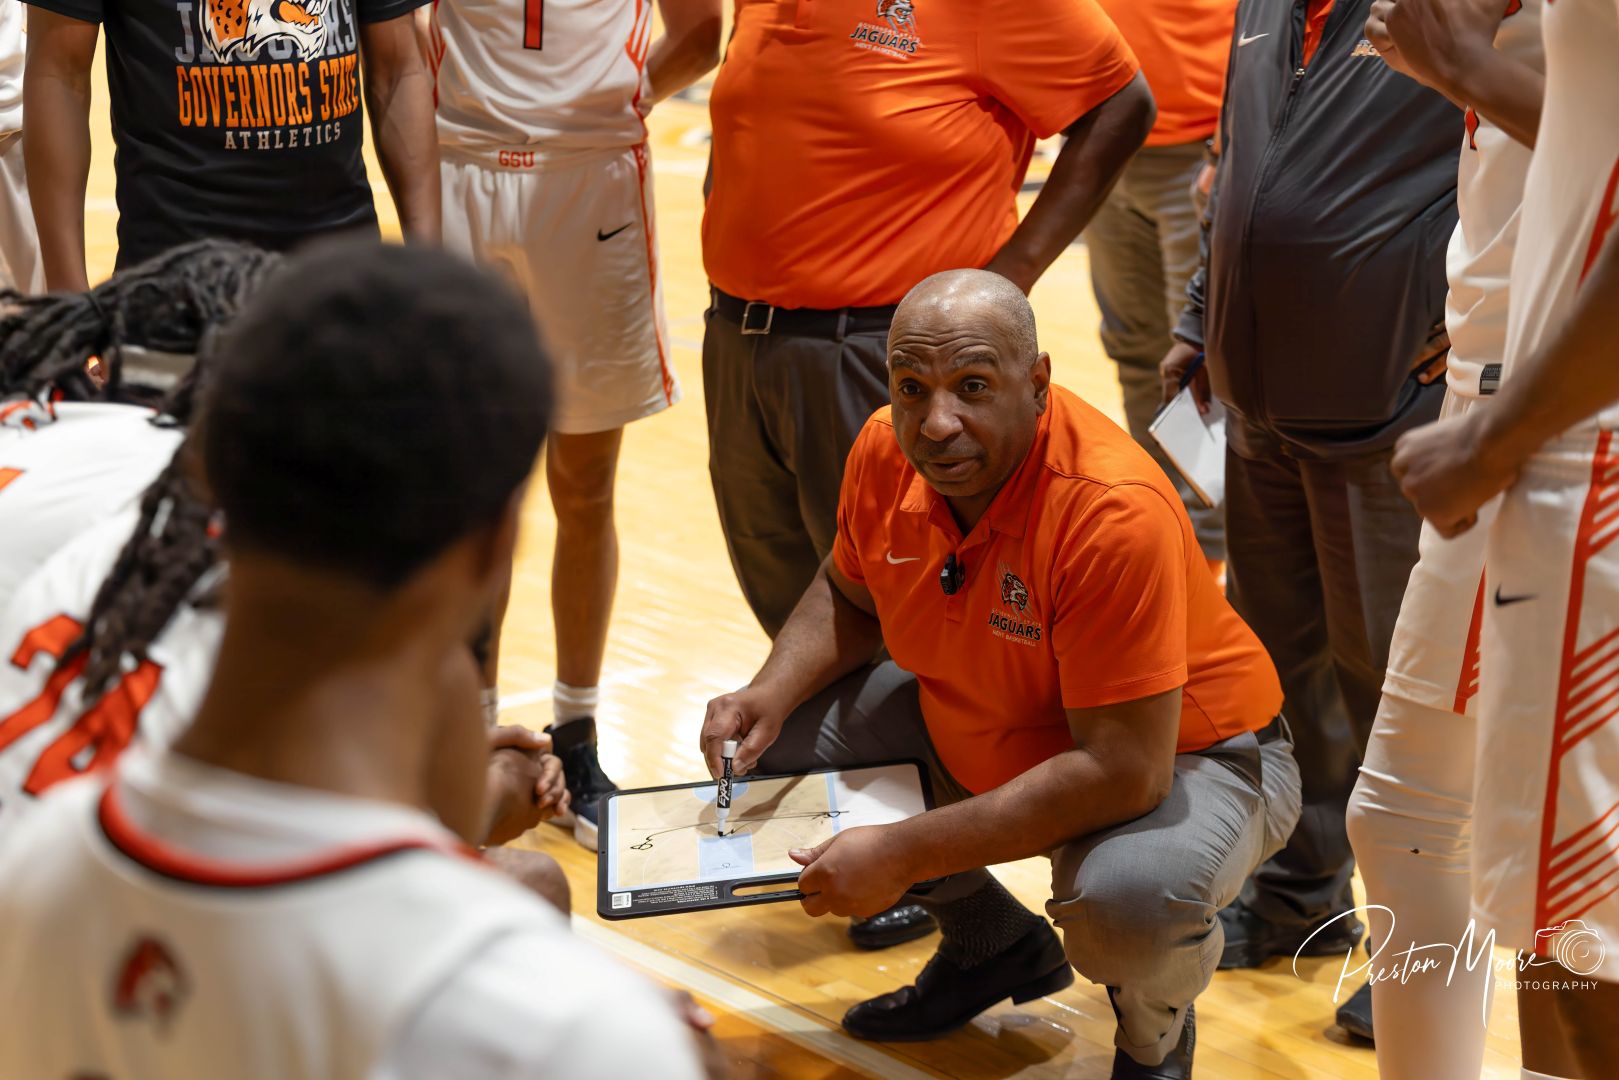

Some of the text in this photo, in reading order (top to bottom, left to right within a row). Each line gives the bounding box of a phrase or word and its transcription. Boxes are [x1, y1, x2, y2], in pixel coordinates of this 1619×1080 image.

[849, 26, 918, 54] JAGUARS
[176, 53, 359, 128] GOVERNORS STATE
[224, 122, 341, 150] ATHLETICS
[499, 150, 535, 168] GSU
[718, 778, 730, 807] EXPO
